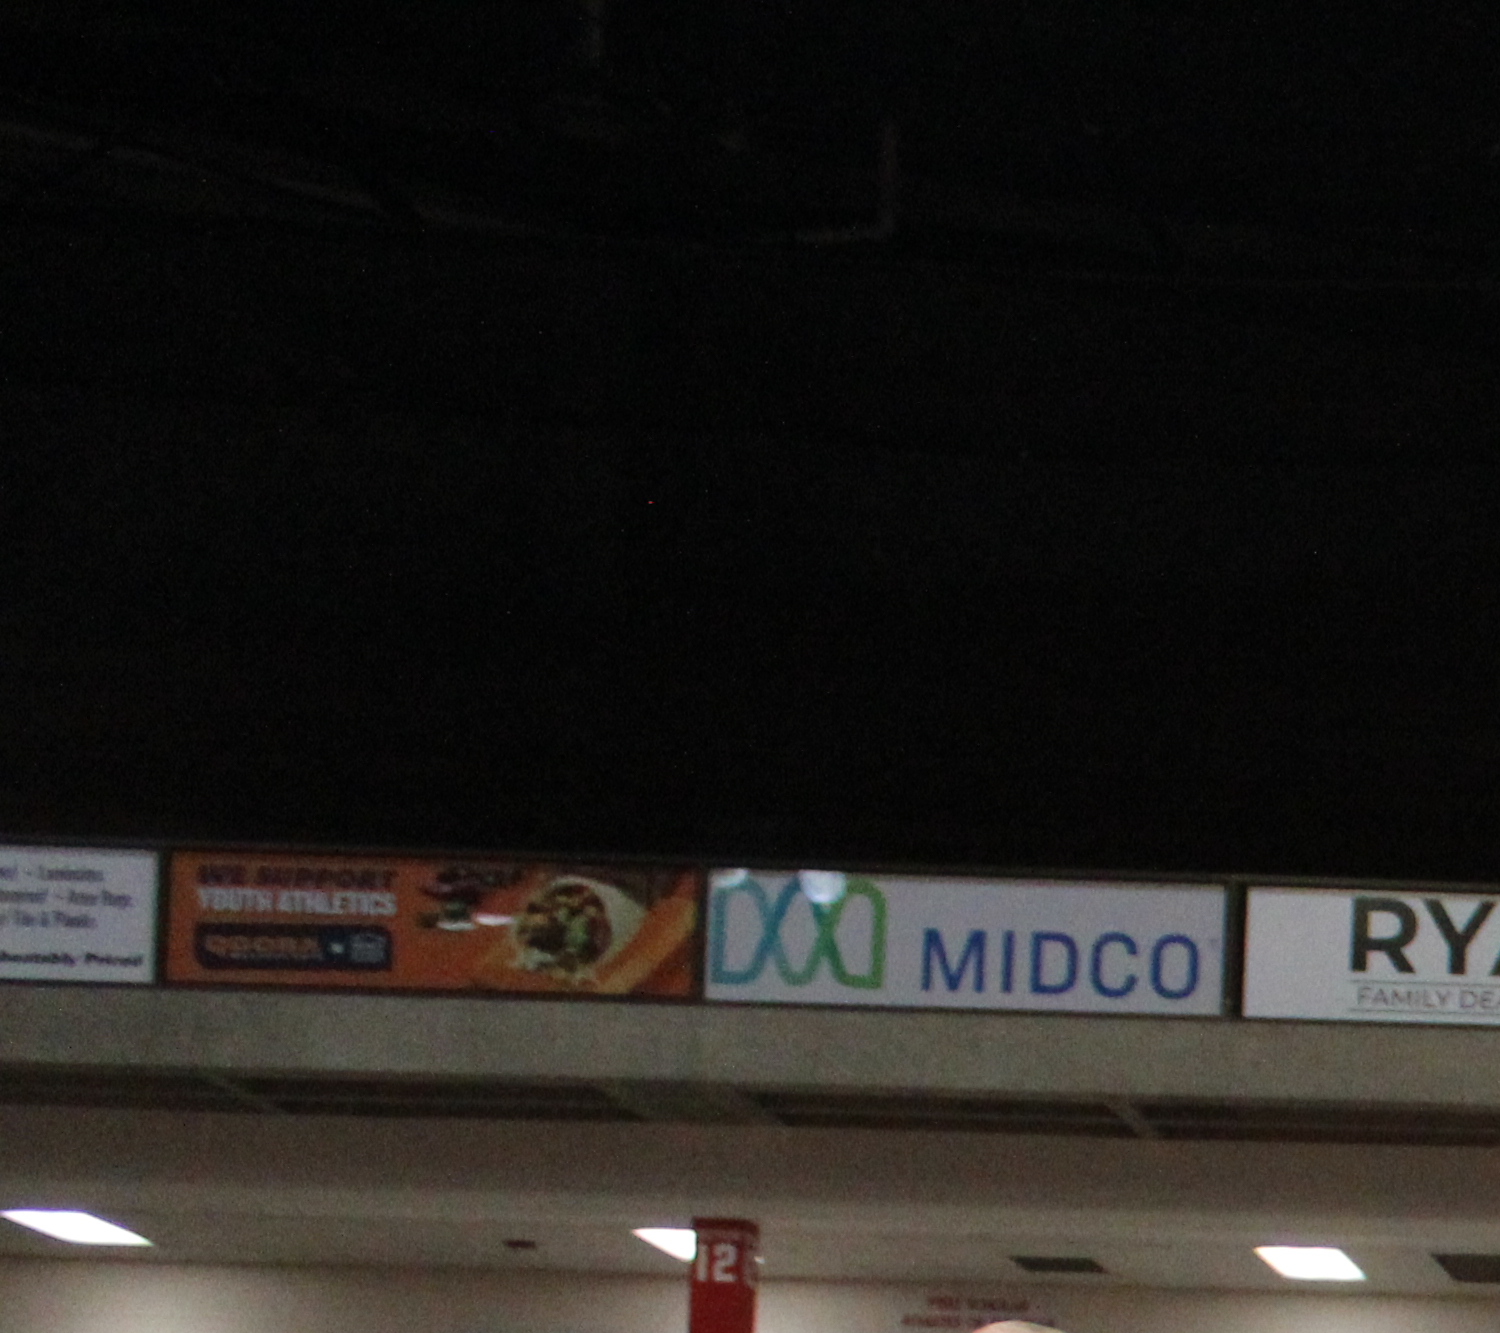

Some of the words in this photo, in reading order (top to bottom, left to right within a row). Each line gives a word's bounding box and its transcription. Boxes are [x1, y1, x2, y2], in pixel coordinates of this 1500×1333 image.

[199, 887, 274, 912] YOUTH
[279, 890, 399, 917] ATHLETICS
[921, 927, 1200, 1000] MIDCO
[1358, 986, 1450, 1011] FAMILY
[696, 1242, 740, 1283] 12
